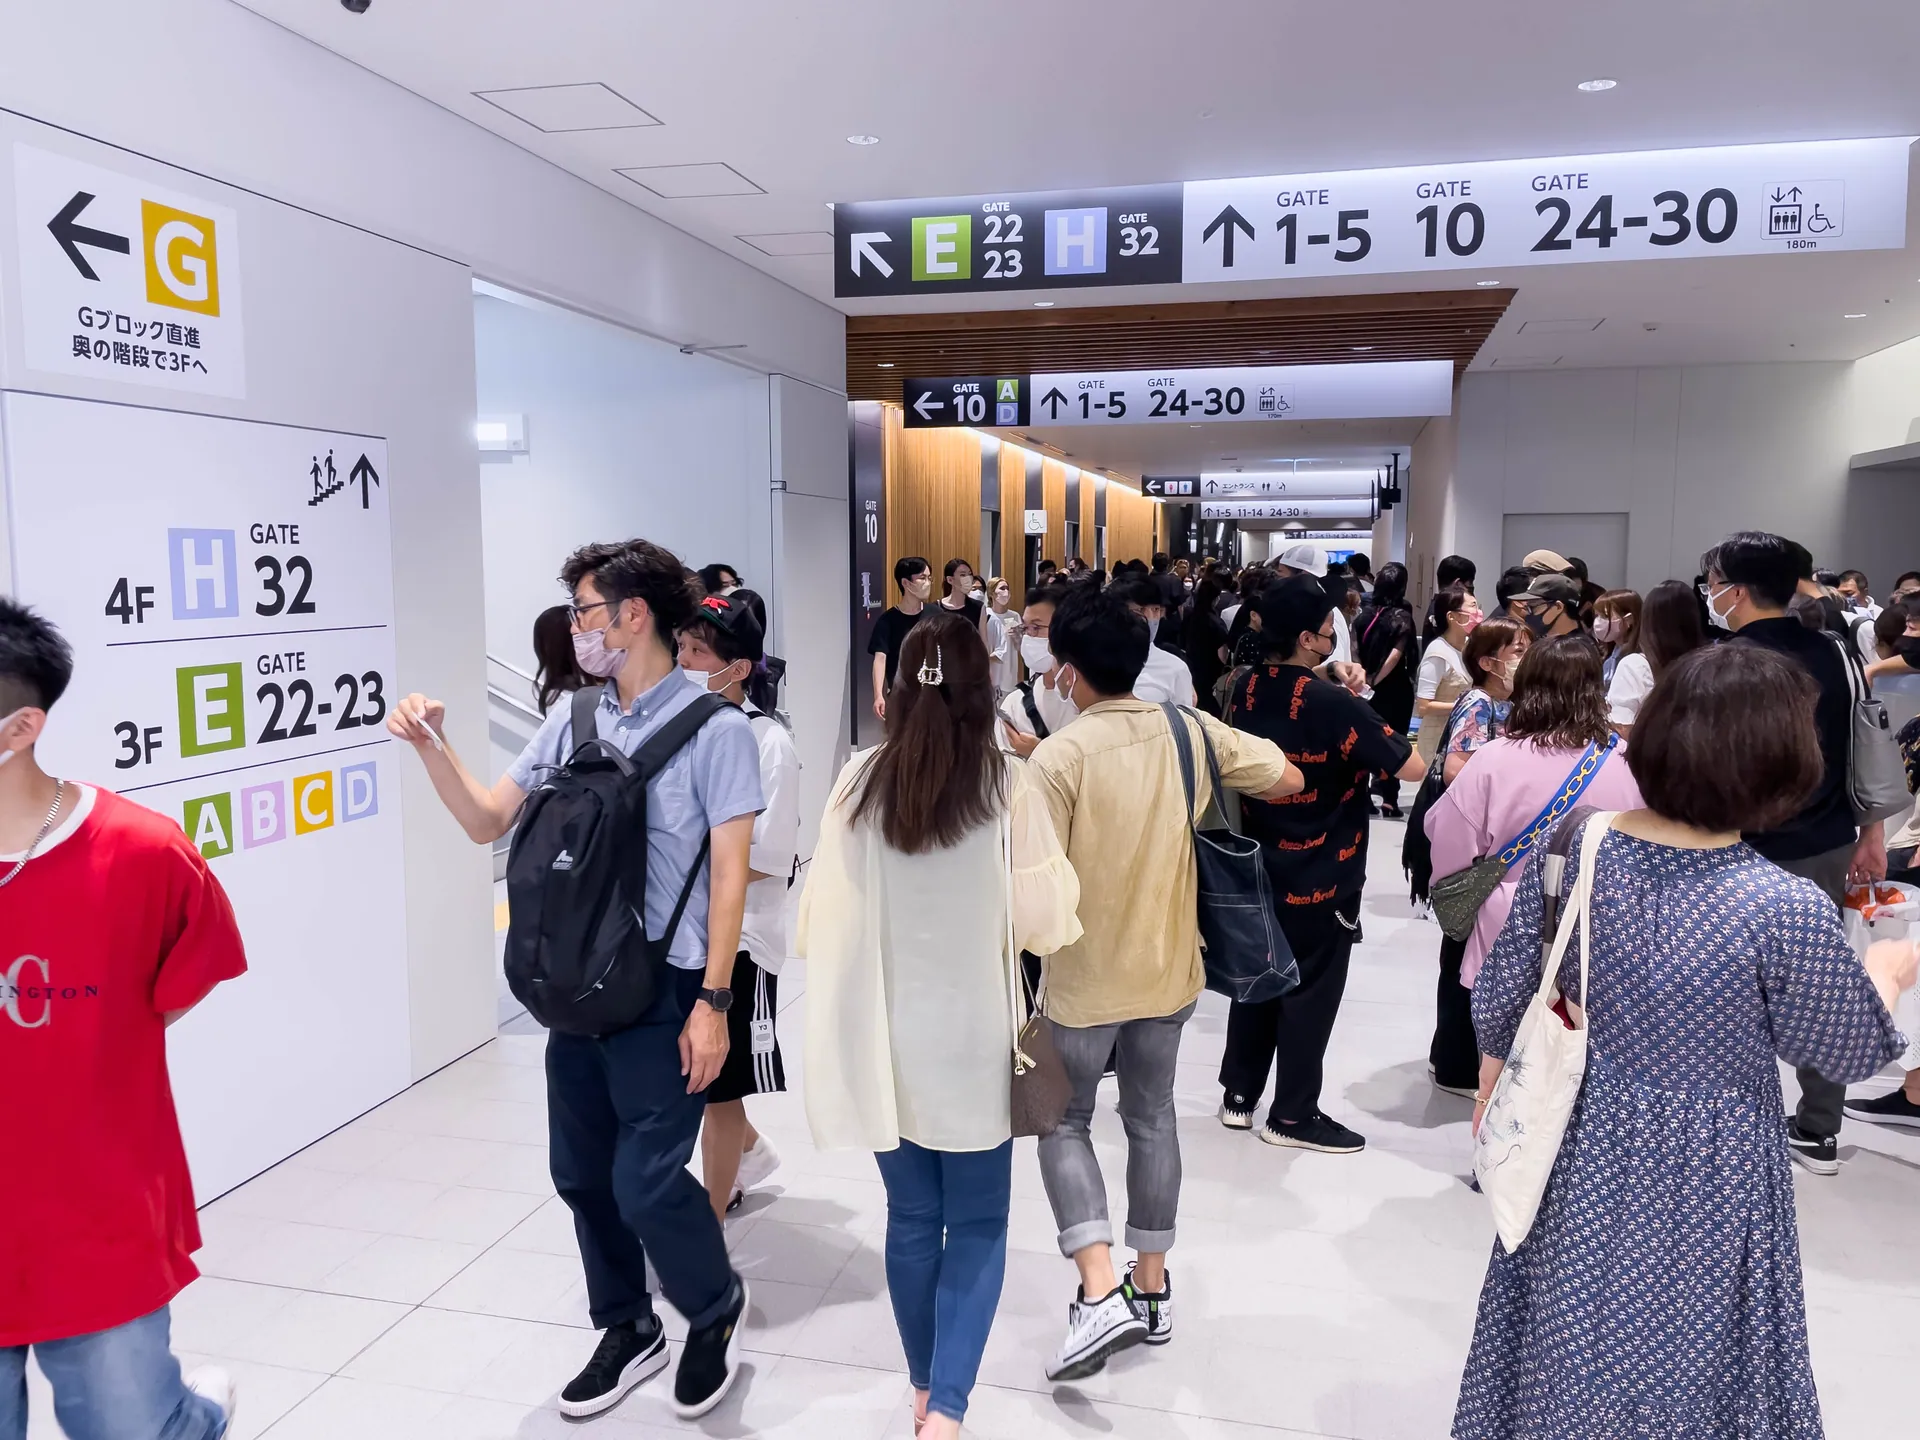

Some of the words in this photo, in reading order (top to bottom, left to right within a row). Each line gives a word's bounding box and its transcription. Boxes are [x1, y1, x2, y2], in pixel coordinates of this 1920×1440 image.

[1416, 180, 1472, 199] GATE
[1531, 172, 1589, 192] GATE
[982, 202, 1010, 213] GATE
[1276, 188, 1330, 208] GATE
[982, 214, 1024, 244] 22
[1118, 213, 1148, 225] GATE
[1415, 201, 1486, 259] 10
[1530, 188, 1739, 253] 24-30
[926, 222, 958, 274] E
[1056, 215, 1095, 268] H
[1119, 226, 1160, 257] 32
[1275, 209, 1372, 266] 1-5
[1786, 240, 1817, 249] 180m
[154, 221, 208, 302] G
[982, 249, 1024, 279] 23
[77, 305, 201, 350] Gブロック直進
[71, 334, 209, 375] 奥の階段で3Fへ
[952, 383, 980, 393] GATE
[999, 381, 1016, 400] A
[1077, 379, 1105, 390] GATE
[1147, 377, 1176, 388] GATE
[952, 395, 987, 423] 10
[999, 405, 1017, 424] D
[1077, 390, 1127, 419] 1-5
[1147, 386, 1246, 417] 24-30
[865, 500, 877, 511] GATE
[1215, 508, 1232, 517] 1-5
[1237, 508, 1264, 517] 11-14
[1269, 507, 1300, 517] 24-30
[249, 523, 300, 546] GATE
[864, 514, 877, 543] 10
[104, 577, 155, 625] 4F
[182, 538, 228, 611] H
[254, 554, 317, 618] 32
[256, 651, 306, 676] GATE
[113, 720, 163, 770] 3F
[193, 673, 232, 746] E
[256, 670, 387, 745] 22-23
[193, 802, 229, 856] A
[251, 789, 279, 842] B
[299, 778, 328, 825] C
[346, 769, 374, 817] D
[0, 954, 51, 1029] C
